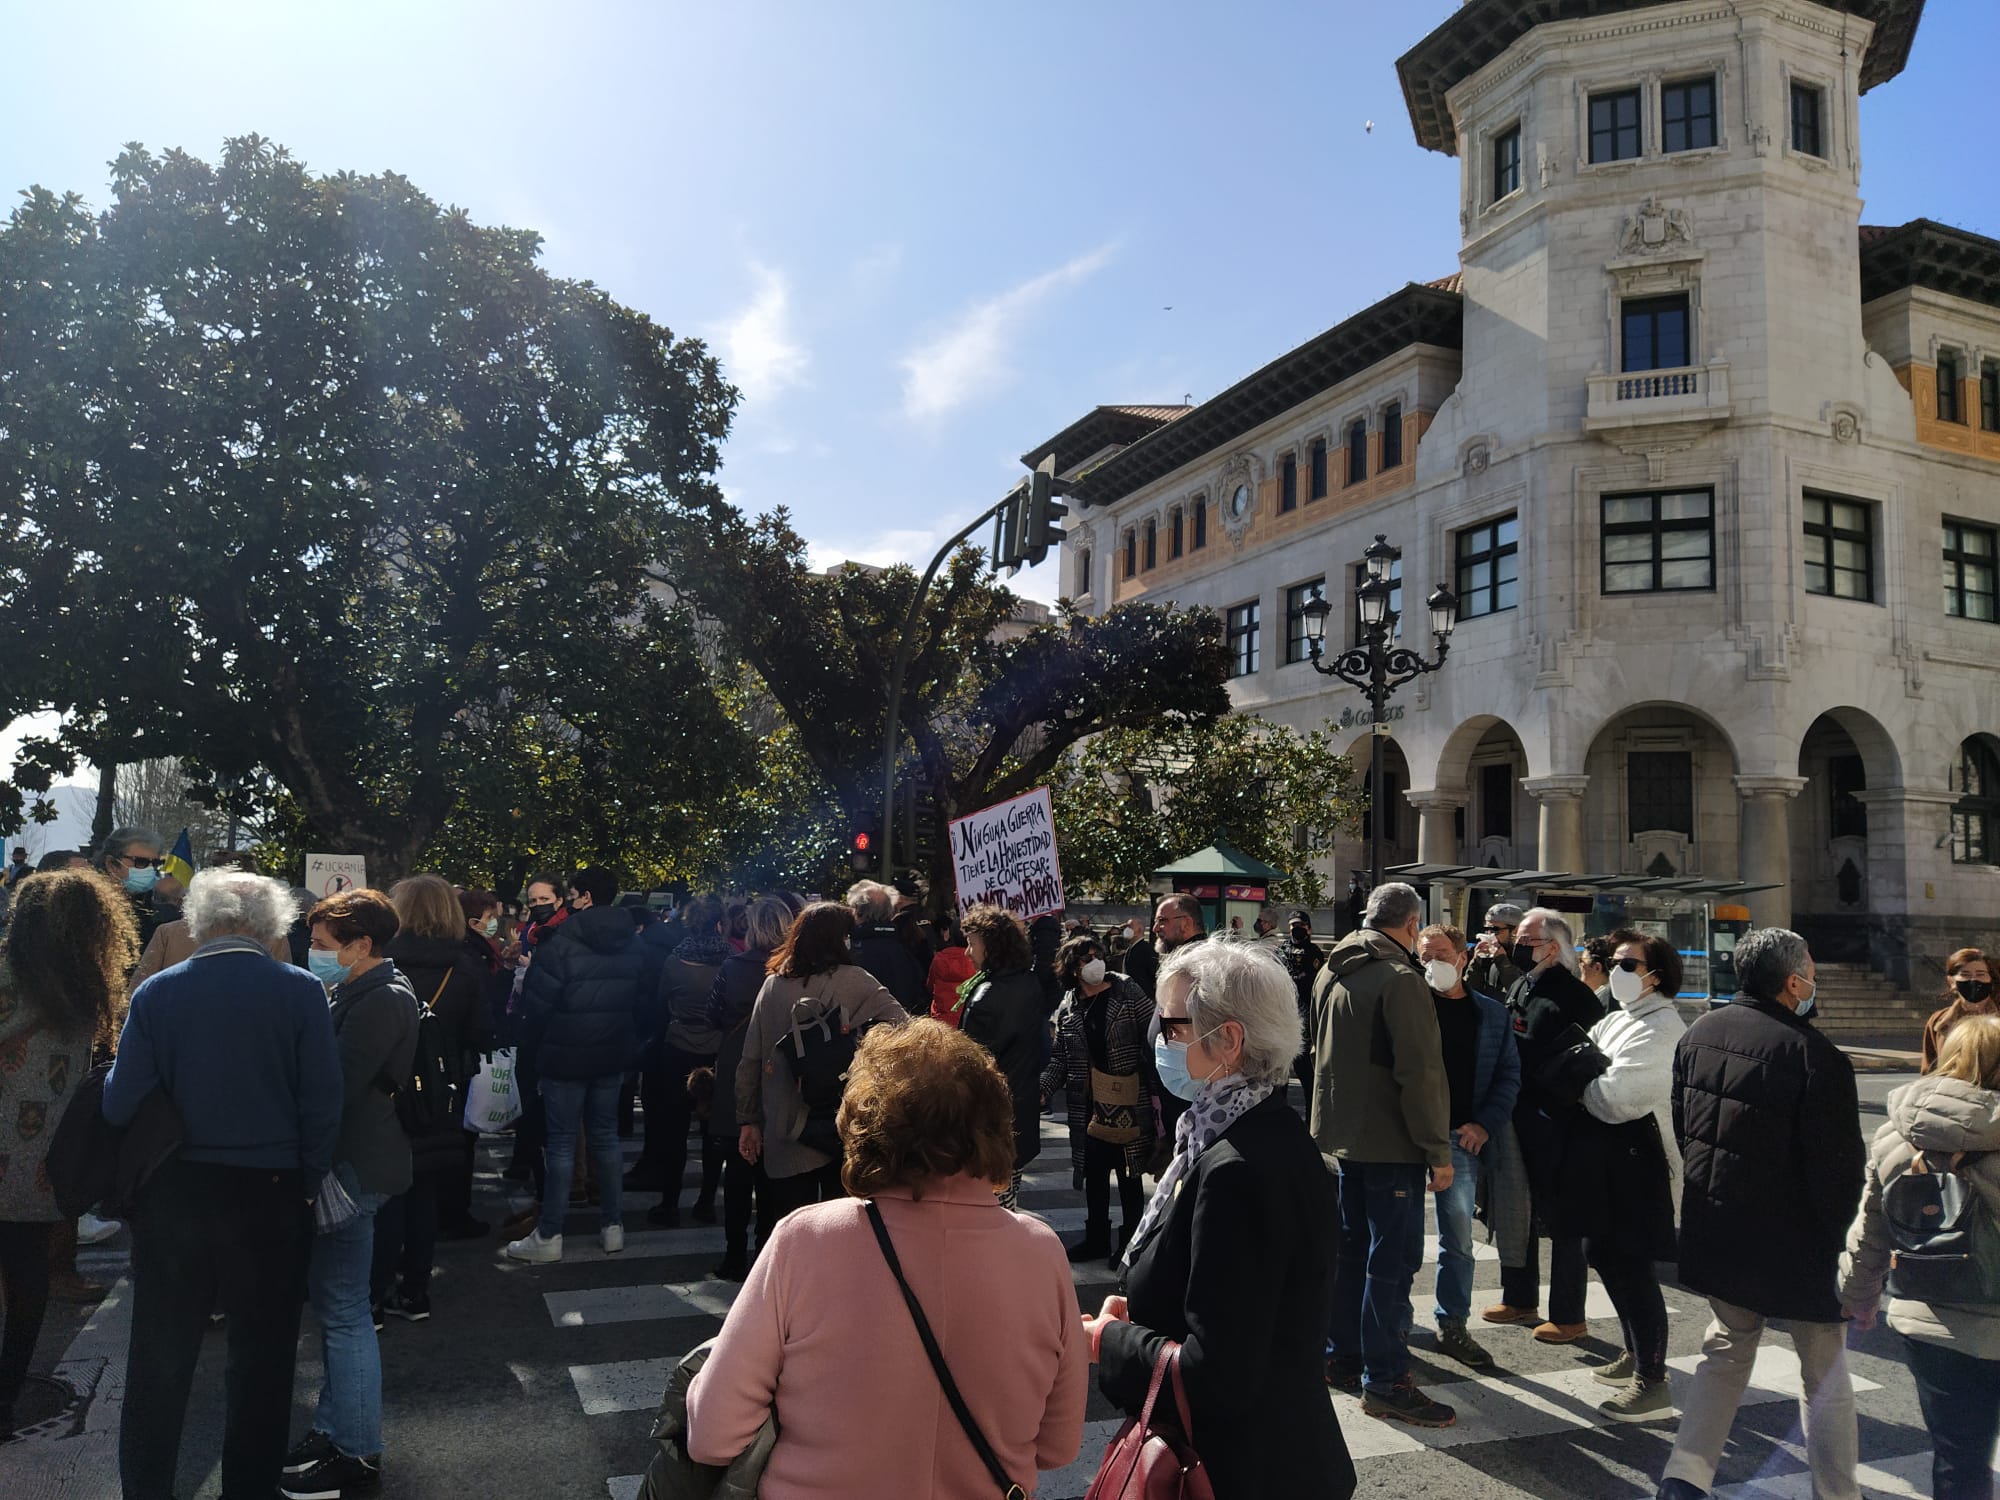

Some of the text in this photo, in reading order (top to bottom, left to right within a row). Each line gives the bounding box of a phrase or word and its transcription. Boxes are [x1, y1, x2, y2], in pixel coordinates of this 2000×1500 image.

[1355, 705, 1405, 726] COEOS
[1007, 802, 1047, 833] GUERRA
[960, 860, 988, 883] TIENE
[998, 831, 1051, 869] HONESTIDAD
[985, 877, 996, 890] DE
